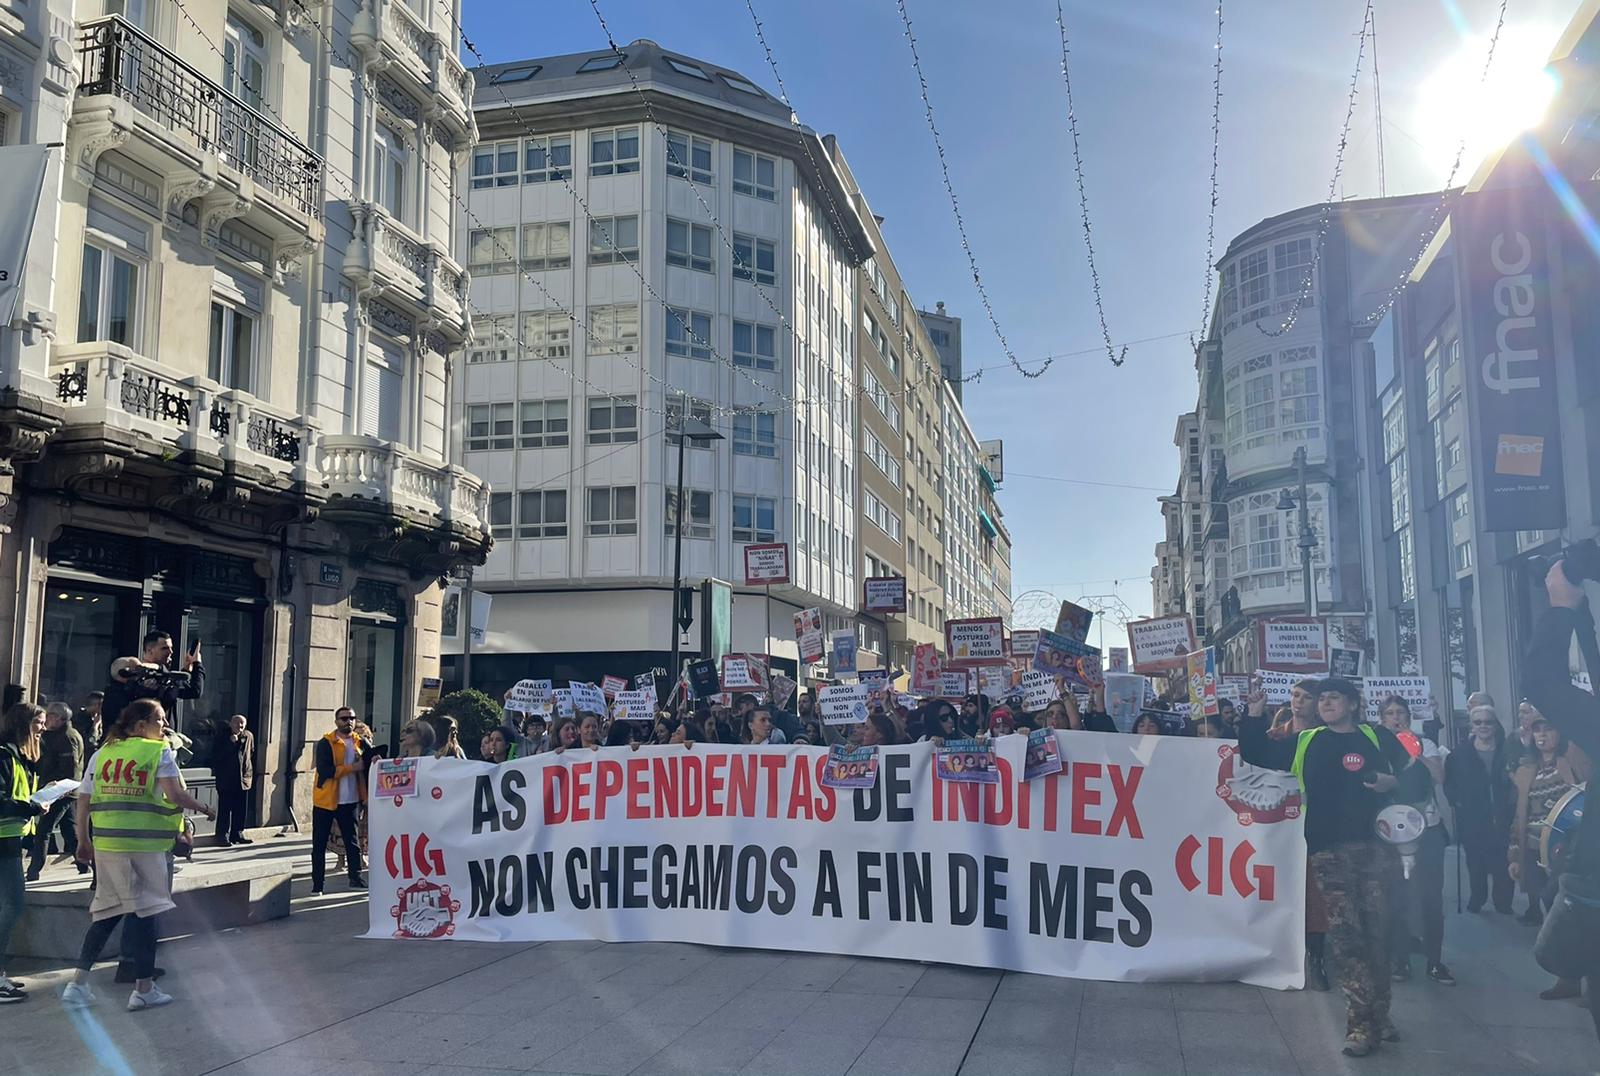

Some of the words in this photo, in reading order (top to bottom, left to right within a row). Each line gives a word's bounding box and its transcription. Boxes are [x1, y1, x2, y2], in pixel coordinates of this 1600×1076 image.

[1482, 231, 1541, 395] fnac
[1497, 441, 1544, 455] fnac
[1134, 623, 1171, 634] TRABALLO
[1141, 639, 1176, 649] COBRAMOS
[970, 648, 1001, 656] DIÑEIRO
[830, 687, 854, 695] SOMOS
[1370, 689, 1423, 697] INDITEX
[820, 695, 867, 703] MPRESCINDIBLES
[822, 711, 854, 720] NVISIBLES
[101, 758, 148, 786] CIG
[471, 769, 527, 835] AS
[542, 753, 837, 826] DEPENDENTAS
[852, 753, 914, 822] DE
[931, 752, 1145, 840] INDITEX
[385, 832, 447, 880] CIG
[1175, 834, 1275, 901] CIG
[407, 890, 441, 912] UGT
[467, 851, 555, 919] NON
[565, 844, 798, 916] CHEGAMOS
[812, 849, 843, 918] A
[857, 850, 933, 924] FIN
[948, 853, 1009, 930] DE
[1028, 860, 1153, 948] MES
